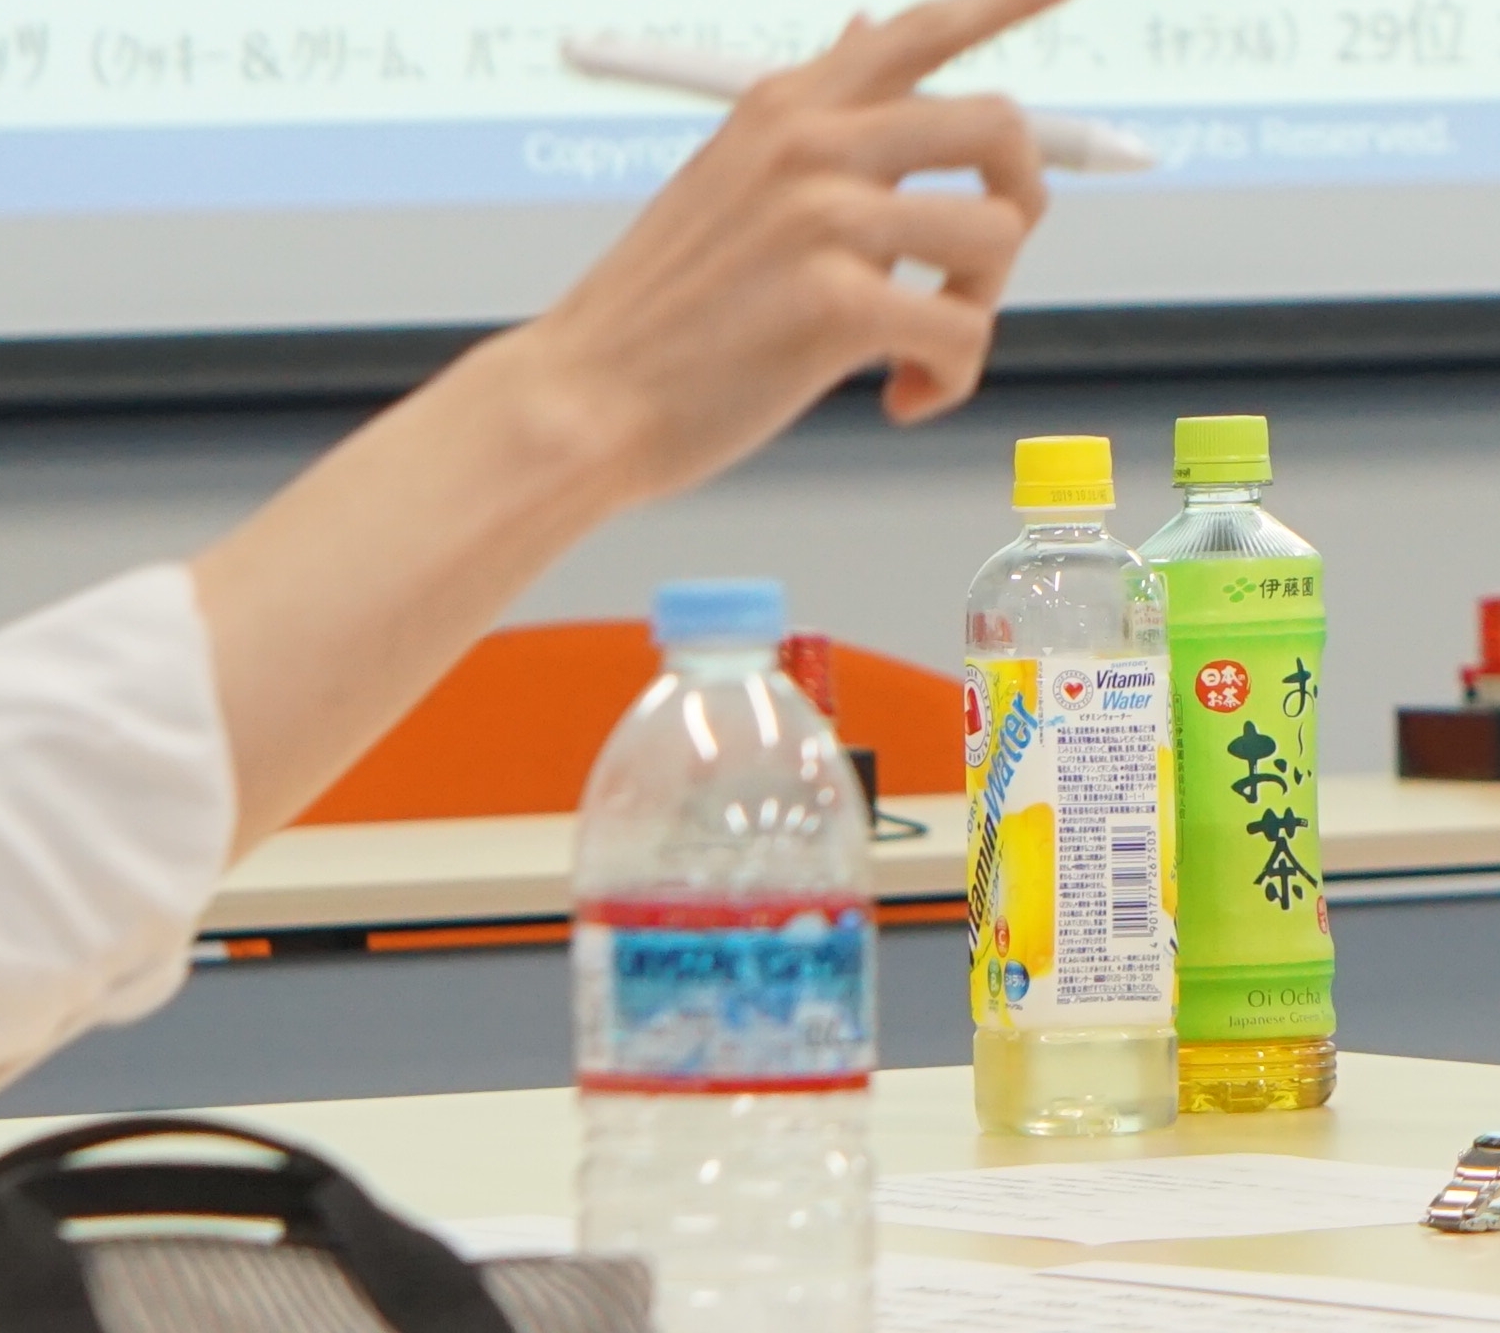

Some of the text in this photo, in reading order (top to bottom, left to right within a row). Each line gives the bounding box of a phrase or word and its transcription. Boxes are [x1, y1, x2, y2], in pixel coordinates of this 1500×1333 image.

[1258, 576, 1314, 600] 伊藤園
[1096, 667, 1156, 689] Vitamin
[1200, 664, 1246, 687] 日本の
[1102, 690, 1153, 711] Water
[1207, 686, 1242, 708] お茶
[983, 691, 1039, 824] Water
[1227, 720, 1319, 911] お茶
[1247, 986, 1322, 1008] Oi Ocha
[1228, 1014, 1286, 1030] Japanese
